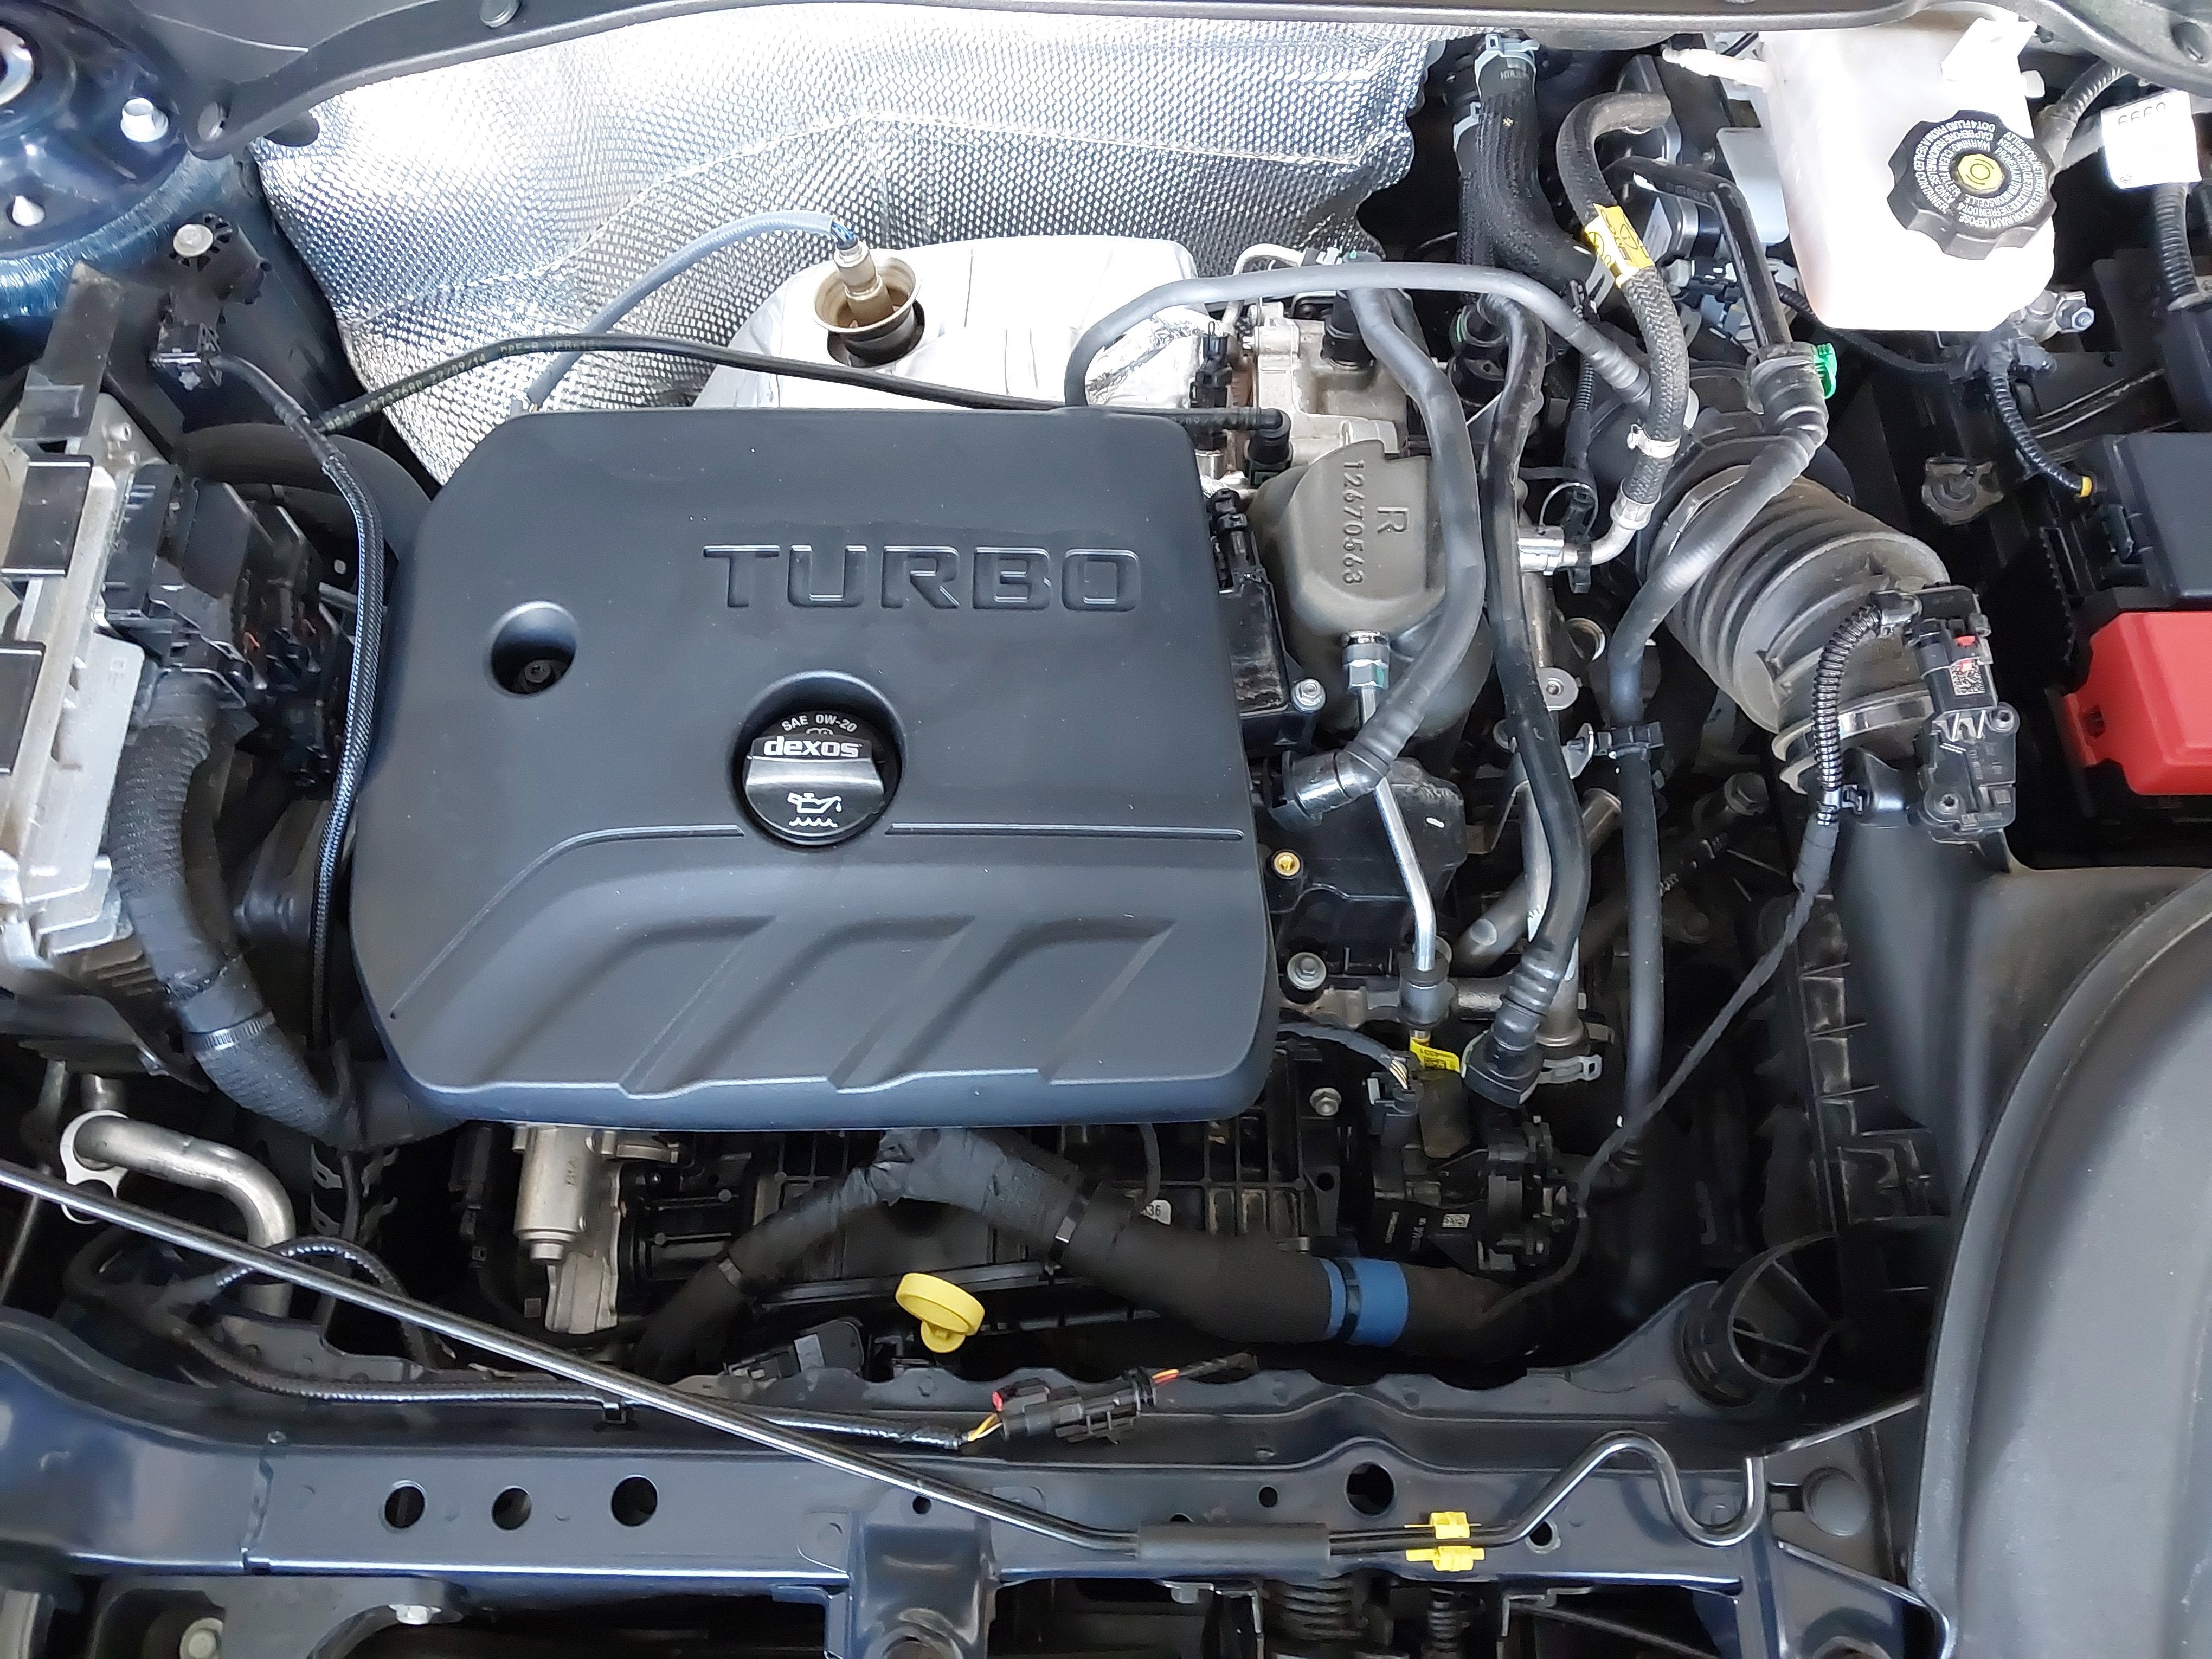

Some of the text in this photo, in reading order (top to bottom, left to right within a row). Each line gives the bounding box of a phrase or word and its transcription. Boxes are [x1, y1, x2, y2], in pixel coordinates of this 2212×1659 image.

[1925, 125, 1948, 142] FROM
[1946, 120, 1971, 131] FLUID
[1976, 121, 1995, 132] DOT
[1943, 128, 1975, 144] BEFORE
[1975, 131, 1993, 141] CAP
[1914, 144, 1928, 171] SEALED
[1938, 149, 1954, 171] CLEAN
[1995, 147, 2021, 182] PROVENANT
[1927, 171, 1941, 186] USE
[1939, 173, 1961, 197] FILLER
[2031, 161, 2046, 194] NETTOYER
[1935, 185, 1955, 203] ONLY
[2031, 191, 2043, 202] LE
[1962, 204, 1978, 216] DOT
[1979, 207, 2003, 217] FREIN
[1999, 205, 2011, 216] DE
[2011, 199, 2041, 223] BOUCHON
[1343, 459, 1366, 585] 12670563
[1377, 506, 1409, 534] R
[703, 544, 1140, 612] TURBO
[781, 713, 858, 733] SAE 0W-20
[763, 735, 859, 758] dexos
